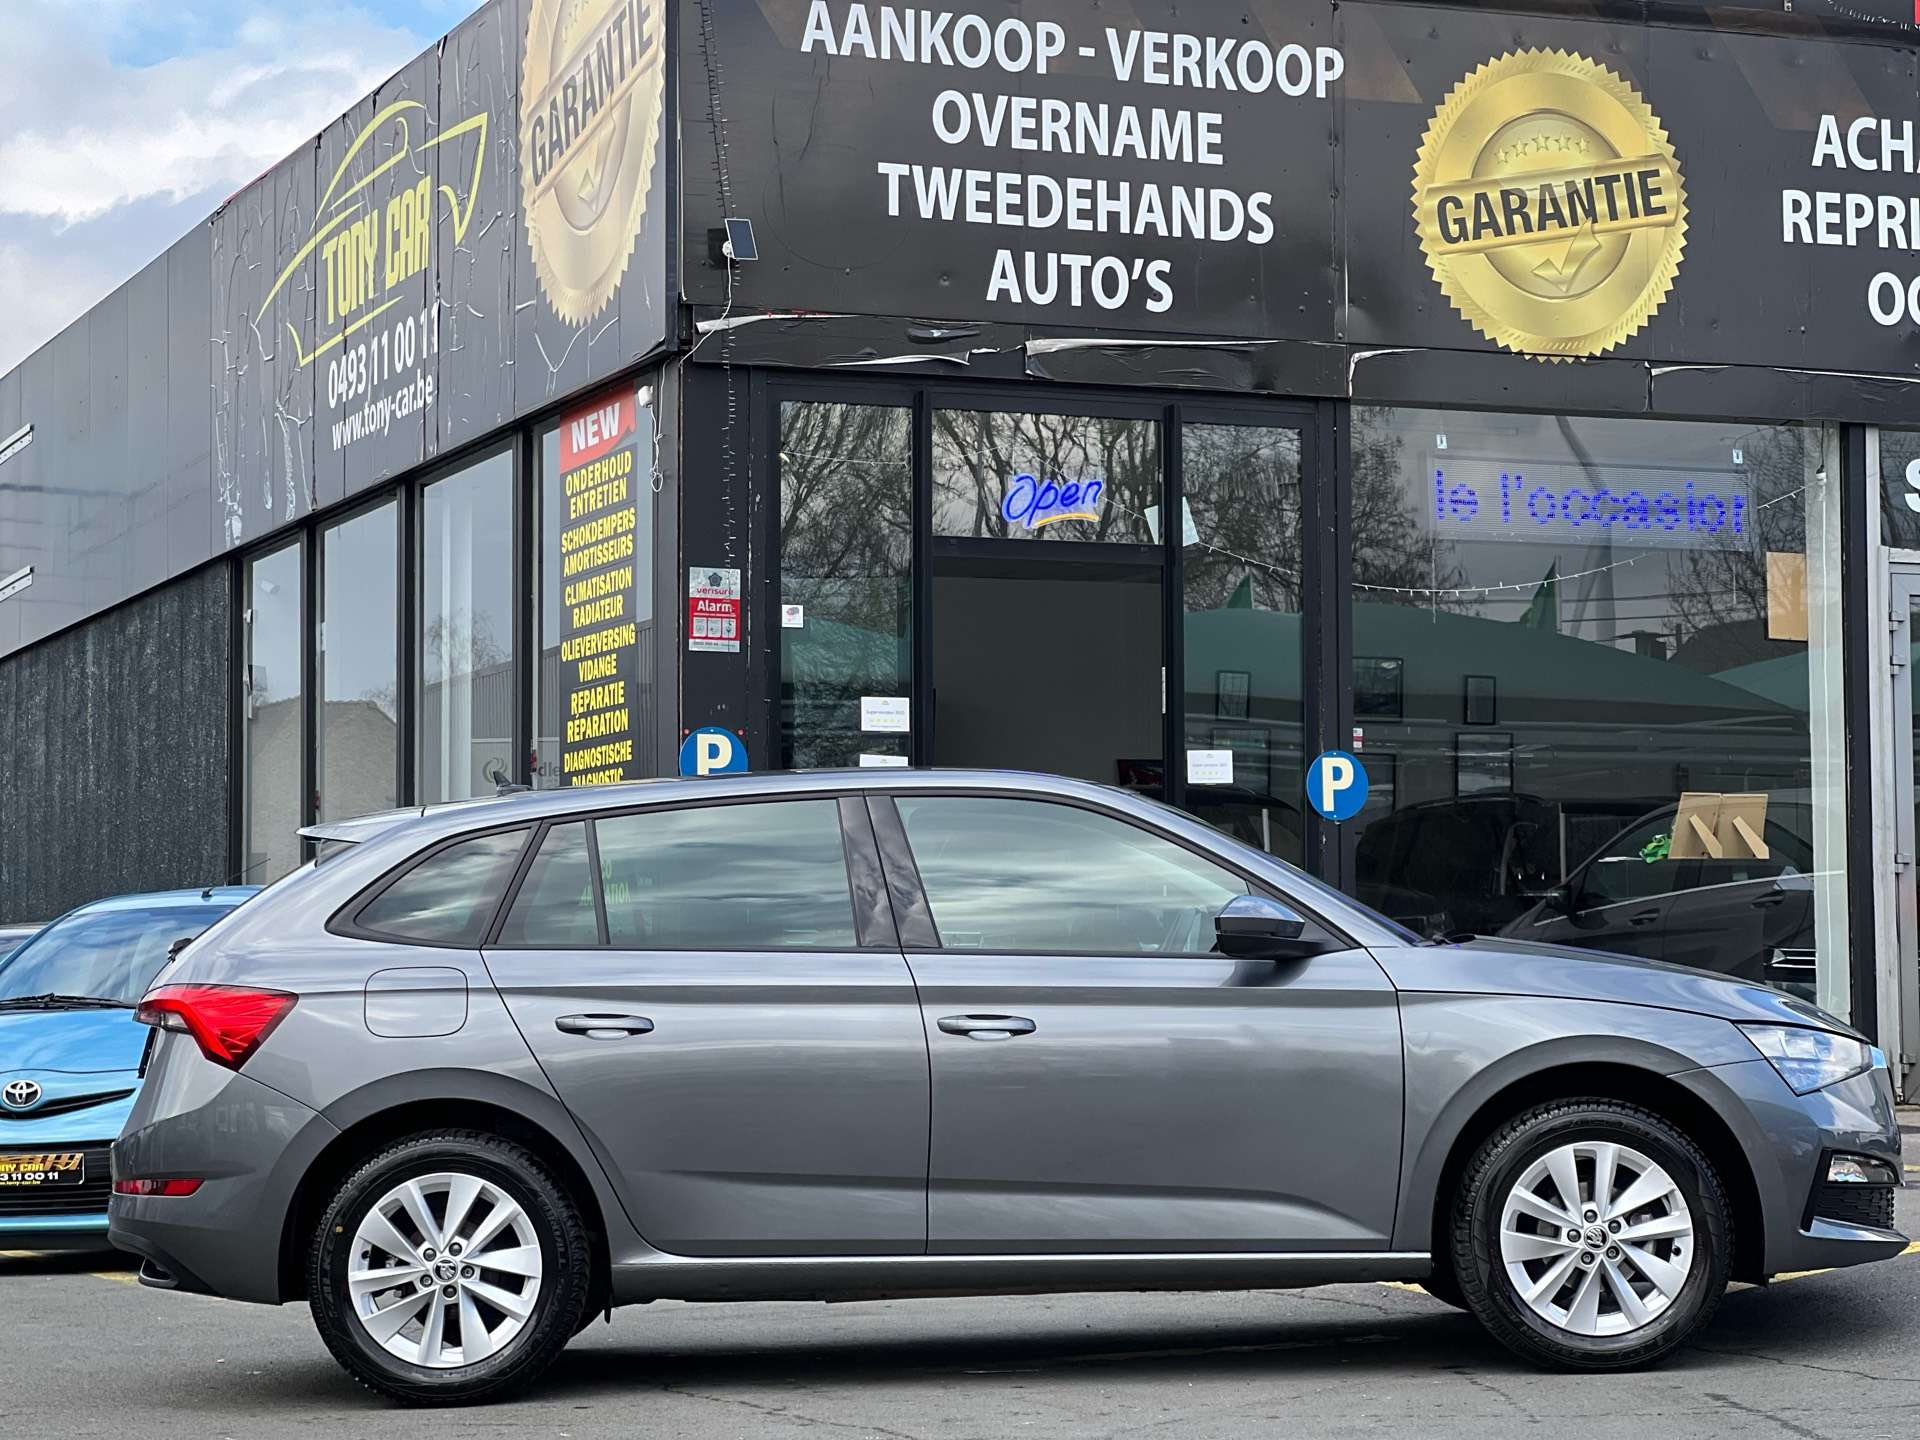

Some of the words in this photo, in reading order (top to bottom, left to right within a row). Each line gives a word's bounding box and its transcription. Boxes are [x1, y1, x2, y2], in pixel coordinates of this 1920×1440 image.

[801, 0, 1064, 74] AANKOOP
[1105, 28, 1345, 98] VERKOOP
[532, 0, 653, 187] GARANTIE
[932, 89, 1224, 165] OVERNAME
[1811, 114, 1920, 173] ACH
[877, 162, 1274, 245] TWEEDEHANDS
[1437, 169, 1667, 244] GARANTIE
[322, 209, 378, 324] TONY
[386, 175, 431, 290] CAR
[986, 249, 1173, 312] AUTO'S
[394, 315, 415, 373] 00
[420, 300, 440, 358] 11
[332, 368, 433, 450] www.tony-car.be
[572, 402, 620, 453] NEW
[566, 451, 632, 496] ONDERHOUD
[570, 477, 627, 519] ENTRETIEN
[1003, 474, 1103, 528] Open
[561, 507, 636, 553] SCHOKDEMPERS
[563, 534, 633, 577] AMORTISSEURS
[564, 566, 632, 607] CLIMATISATION
[697, 599, 733, 612] Alarm
[573, 595, 624, 629] RADIATEUR
[561, 623, 636, 662] OLIEVERVERSING
[578, 653, 617, 683] VIDANGE
[571, 681, 625, 716] REPARATIE
[567, 708, 629, 744] RÉPARATION
[564, 740, 633, 773] DIAGNOSTISCHE
[1321, 757, 1354, 812] P
[0, 1164, 17, 1172] NY
